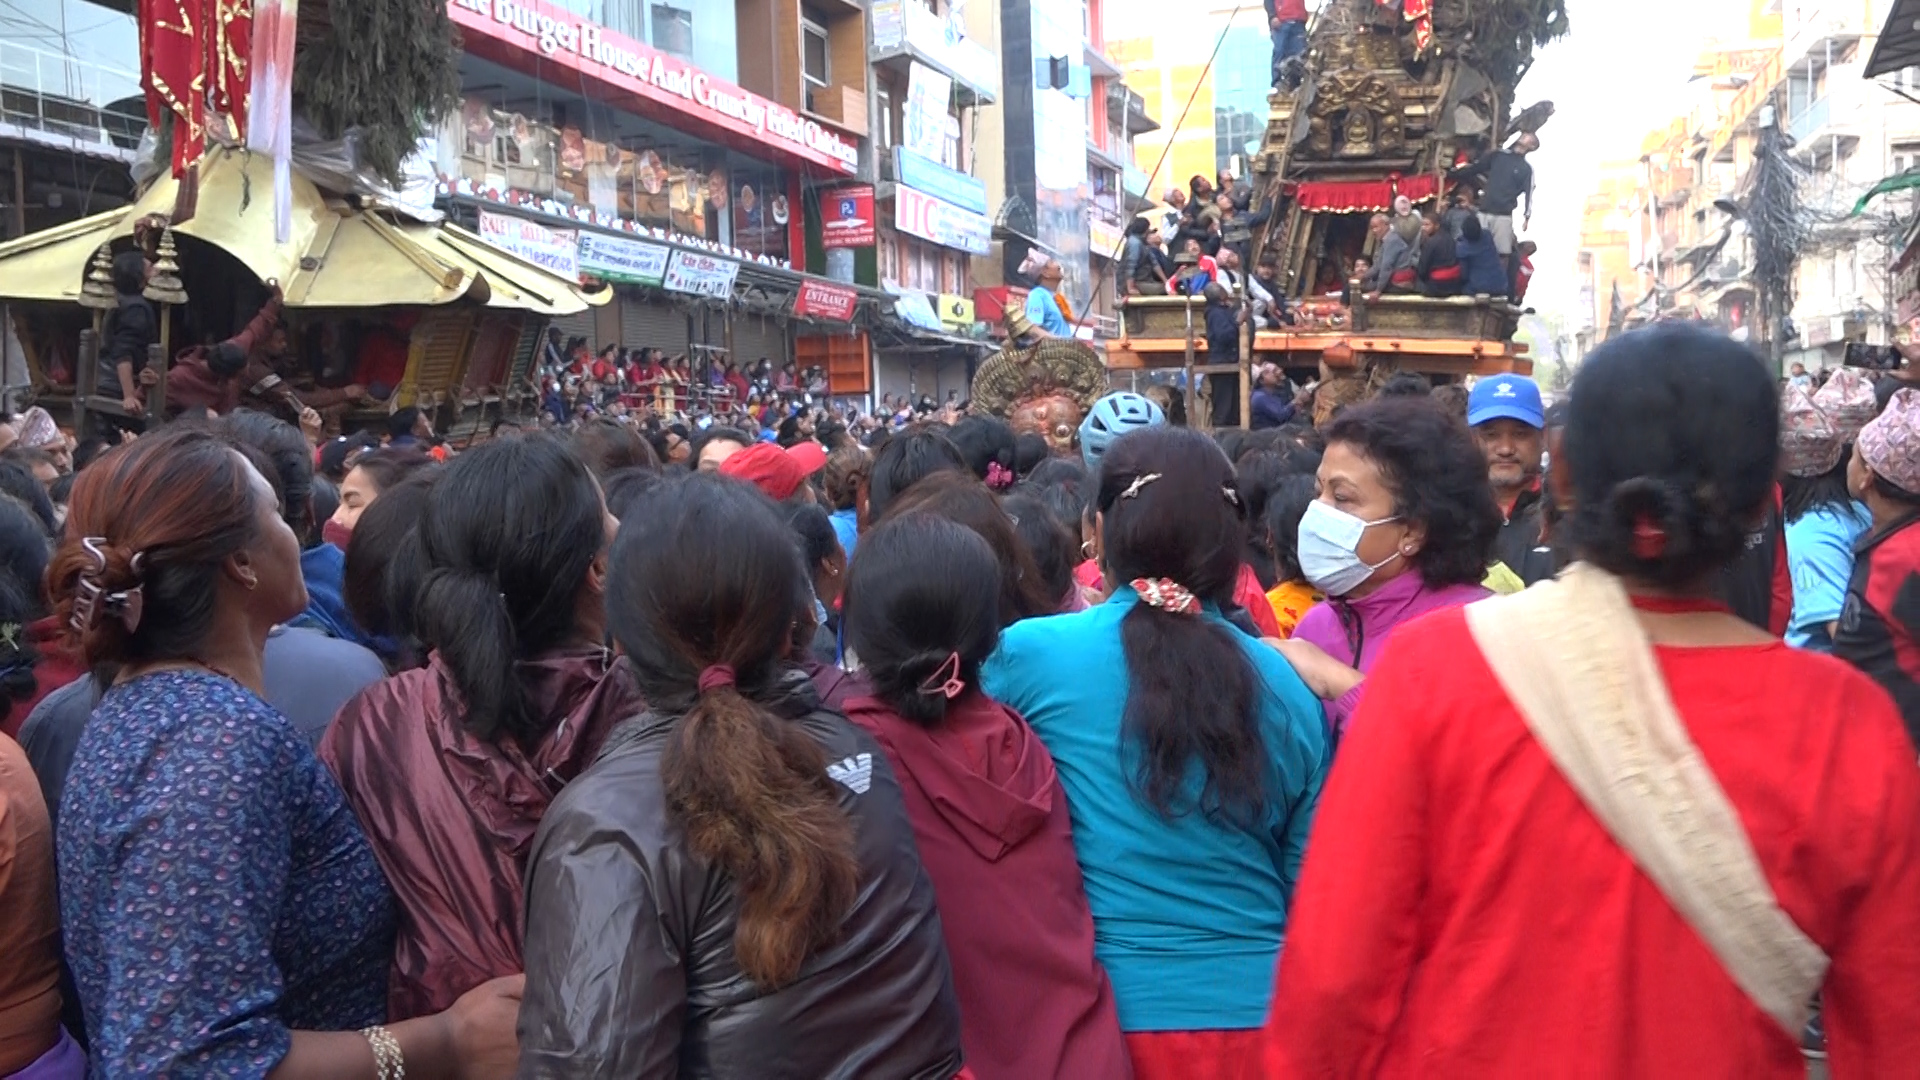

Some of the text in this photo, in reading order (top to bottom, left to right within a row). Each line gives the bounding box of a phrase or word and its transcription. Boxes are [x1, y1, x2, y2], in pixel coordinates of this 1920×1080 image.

[495, 0, 579, 54] Burger
[579, 22, 651, 82] House
[650, 55, 693, 100] And
[693, 73, 766, 135] Crunchy
[766, 104, 805, 144] Fried
[804, 121, 858, 166] Chicken
[899, 187, 938, 238] ITC
[804, 289, 849, 308] ENTRANCE
